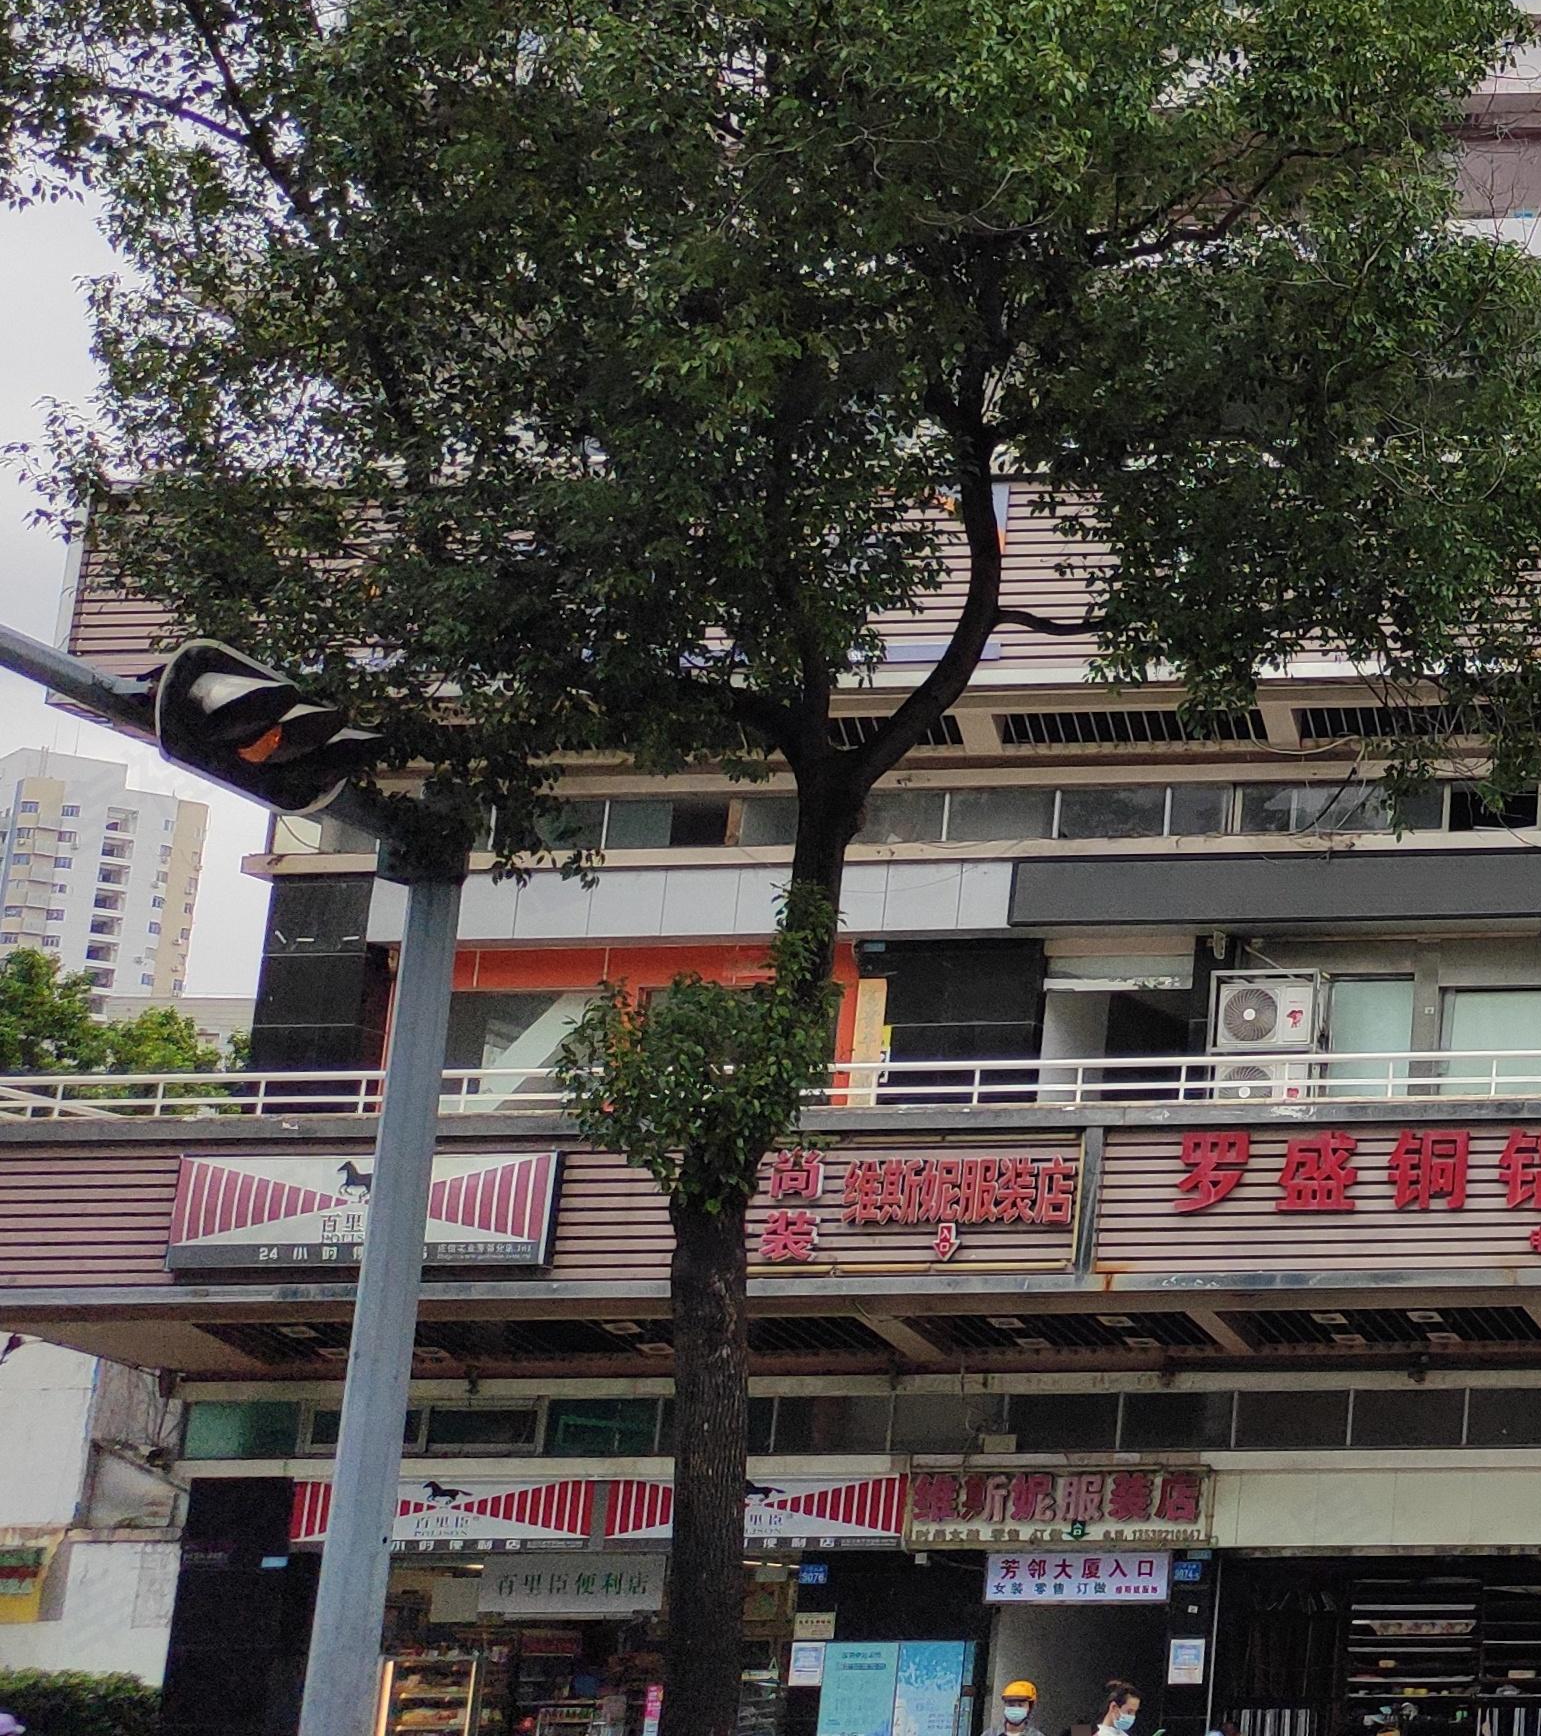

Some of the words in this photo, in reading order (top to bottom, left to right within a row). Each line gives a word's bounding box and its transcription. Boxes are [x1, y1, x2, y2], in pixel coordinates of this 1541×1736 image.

[842, 1153, 1077, 1225] 维斯妮服装店
[320, 1210, 366, 1234] 百里
[912, 1471, 1202, 1524] 维斯妮服装店
[1000, 1558, 1156, 1580] 芳邻大厦入口
[497, 1570, 649, 1596] 百里臣便利店
[992, 1582, 1024, 1596] 女装
[1033, 1582, 1065, 1596] 零售
